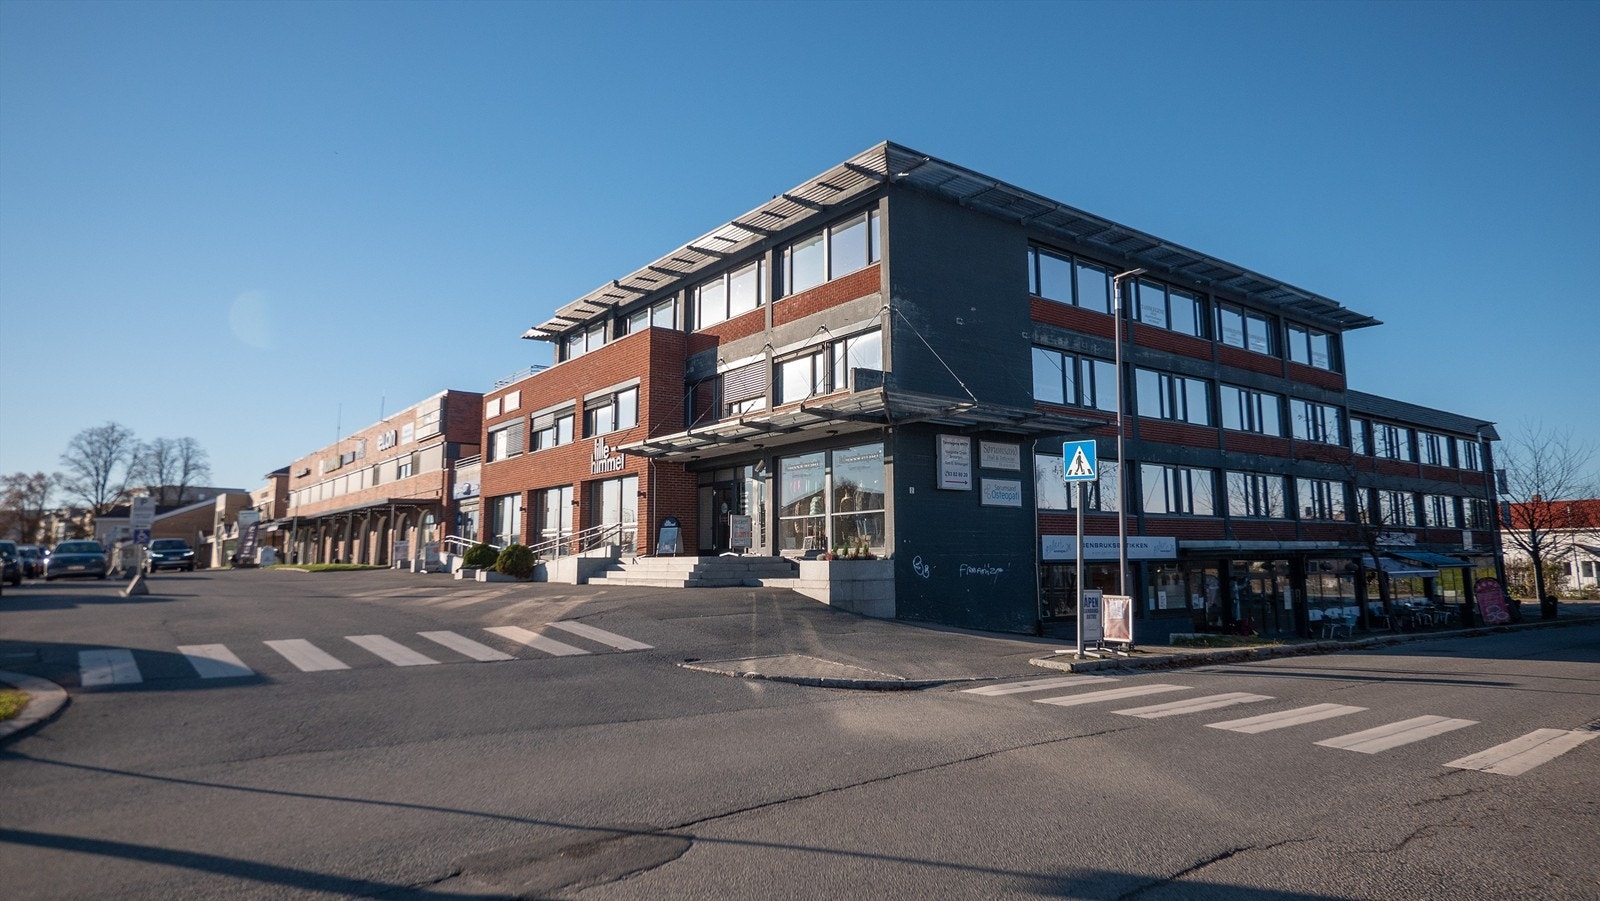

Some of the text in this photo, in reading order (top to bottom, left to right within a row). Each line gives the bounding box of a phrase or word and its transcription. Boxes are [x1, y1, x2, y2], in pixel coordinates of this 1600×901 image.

[594, 437, 610, 460] lille
[591, 453, 625, 475] himmel
[991, 490, 1020, 501] Osteopati
[1084, 595, 1098, 607] ÅPEN
